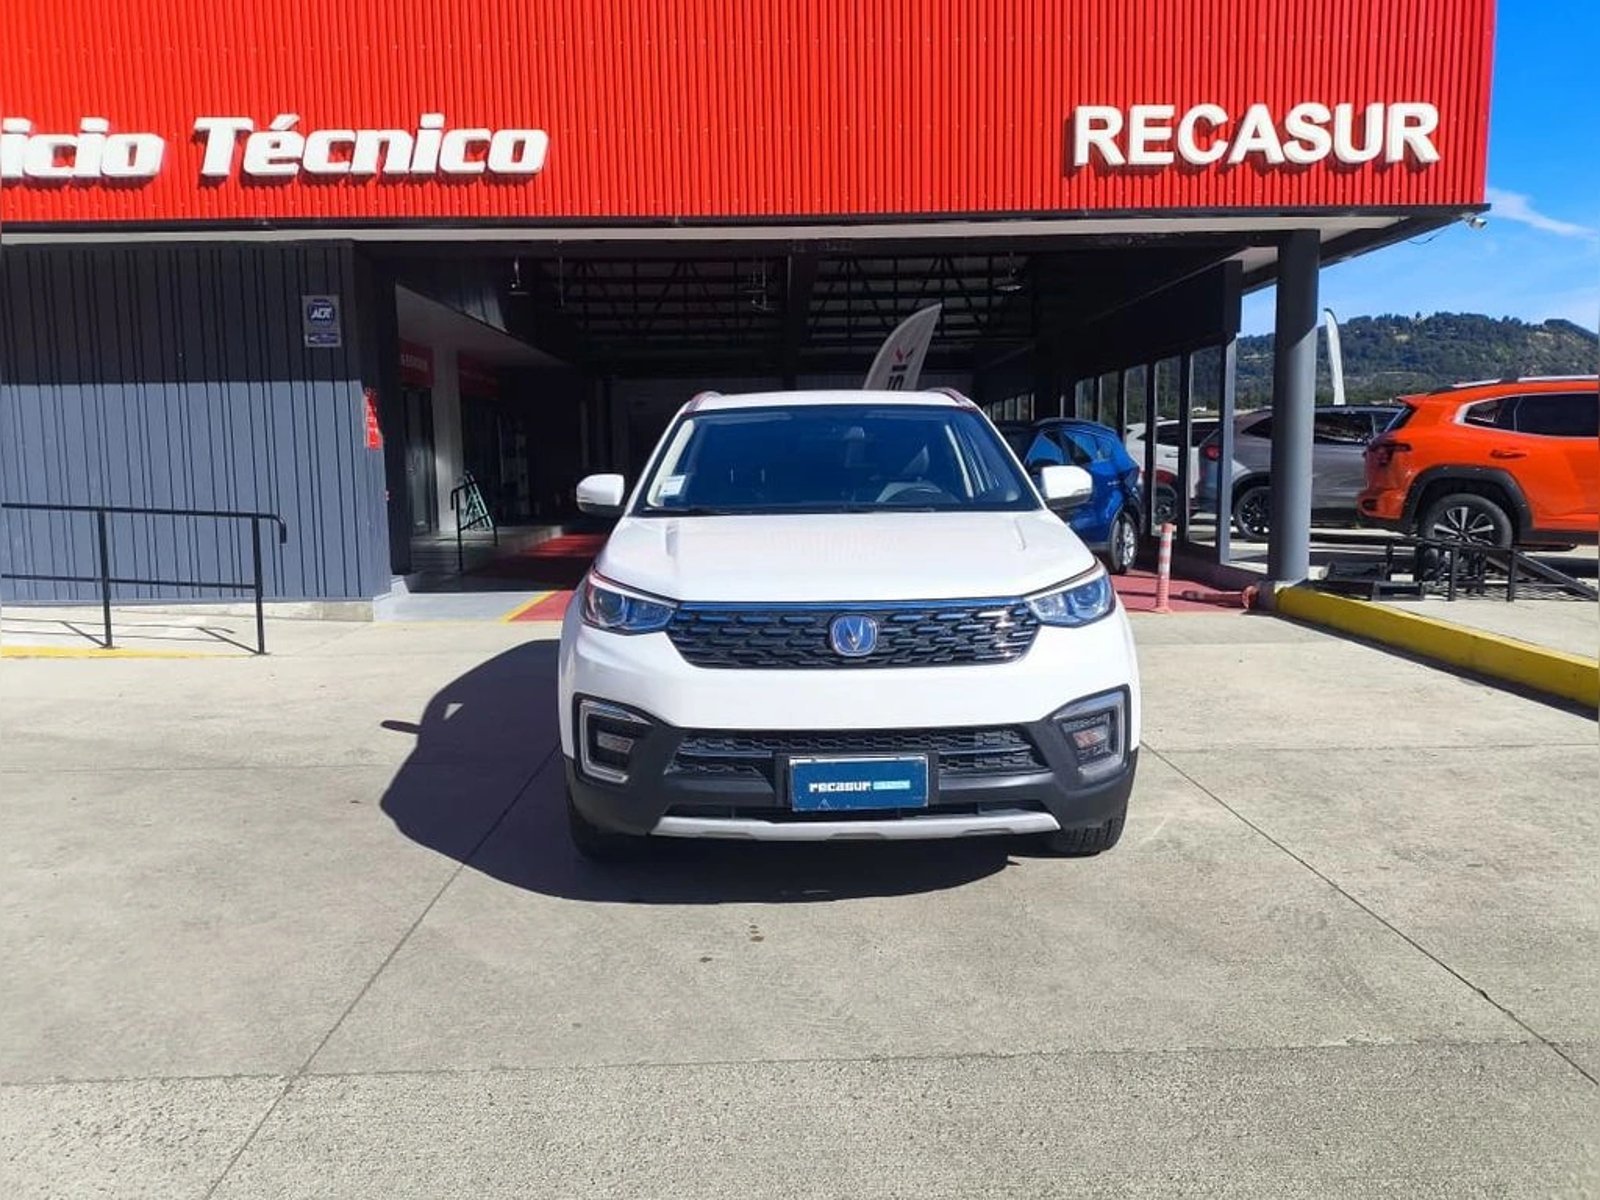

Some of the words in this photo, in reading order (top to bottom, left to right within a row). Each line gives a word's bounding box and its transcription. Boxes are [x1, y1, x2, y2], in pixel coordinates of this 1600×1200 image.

[194, 113, 549, 177] Técnico
[1074, 102, 1440, 166] RECASUR
[809, 781, 871, 793] recasur
